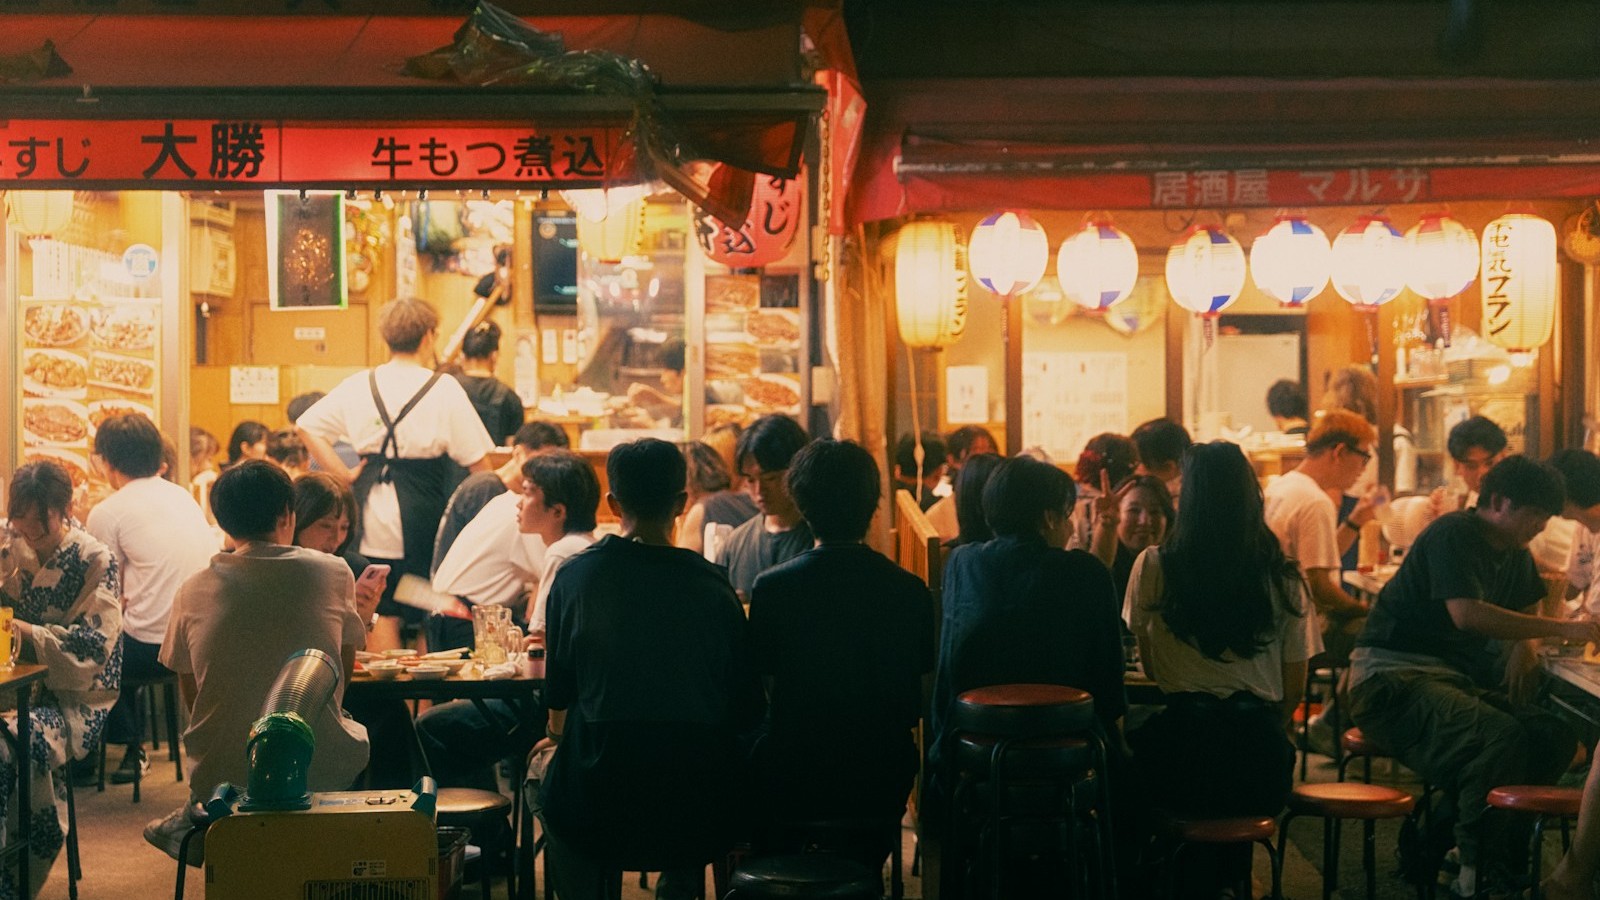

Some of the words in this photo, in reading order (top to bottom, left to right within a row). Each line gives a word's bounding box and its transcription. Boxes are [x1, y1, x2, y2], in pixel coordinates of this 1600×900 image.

[0, 136, 91, 178] すじ
[141, 122, 265, 178] 大勝
[371, 136, 605, 180] 牛もつ煮込
[1154, 170, 1267, 206] 居酒屋
[1299, 168, 1427, 204] マルサ
